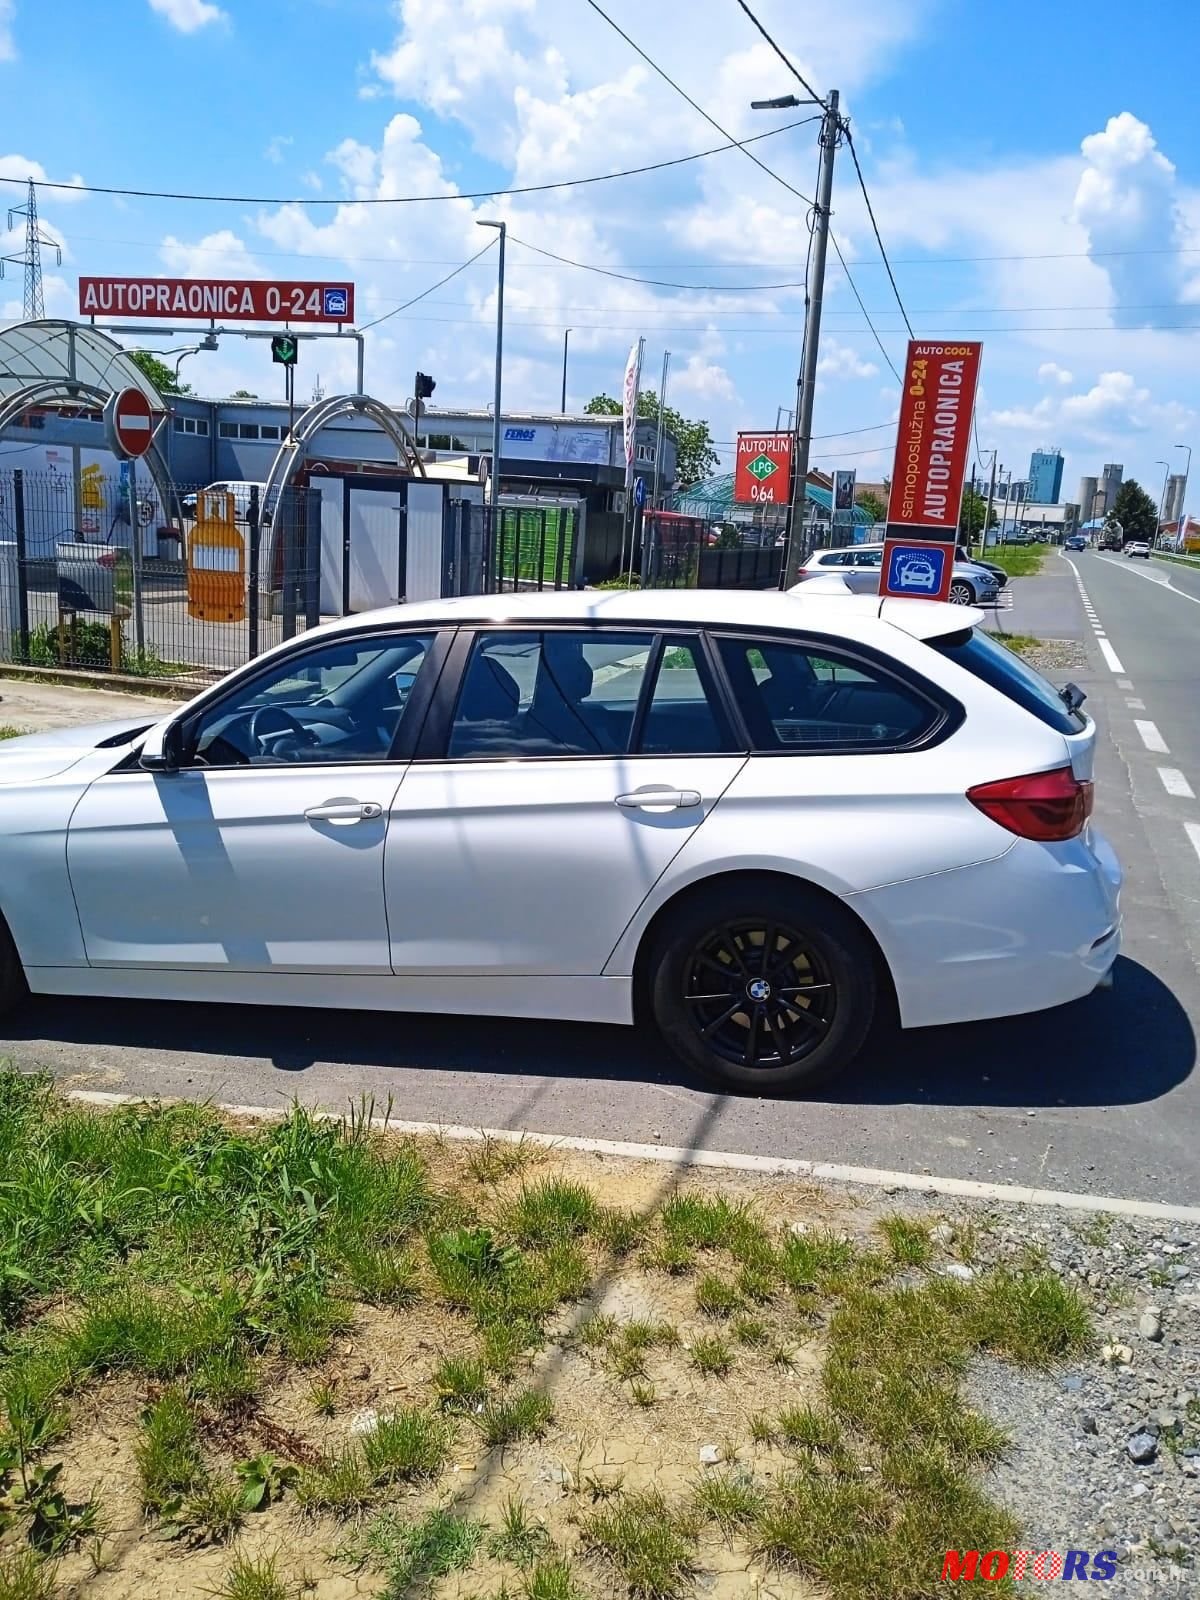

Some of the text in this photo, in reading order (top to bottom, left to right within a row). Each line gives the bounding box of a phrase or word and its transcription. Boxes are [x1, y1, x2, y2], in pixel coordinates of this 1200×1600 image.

[84, 283, 322, 316] AUTOPRAONICA 0-24
[504, 428, 537, 440] FEROS
[902, 359, 928, 518] samoposlužna 0-24
[923, 360, 965, 520] AUTOPRAONICA
[739, 440, 789, 453] AUTOPLIN
[753, 462, 772, 473] LPG
[751, 485, 774, 502] 0,64
